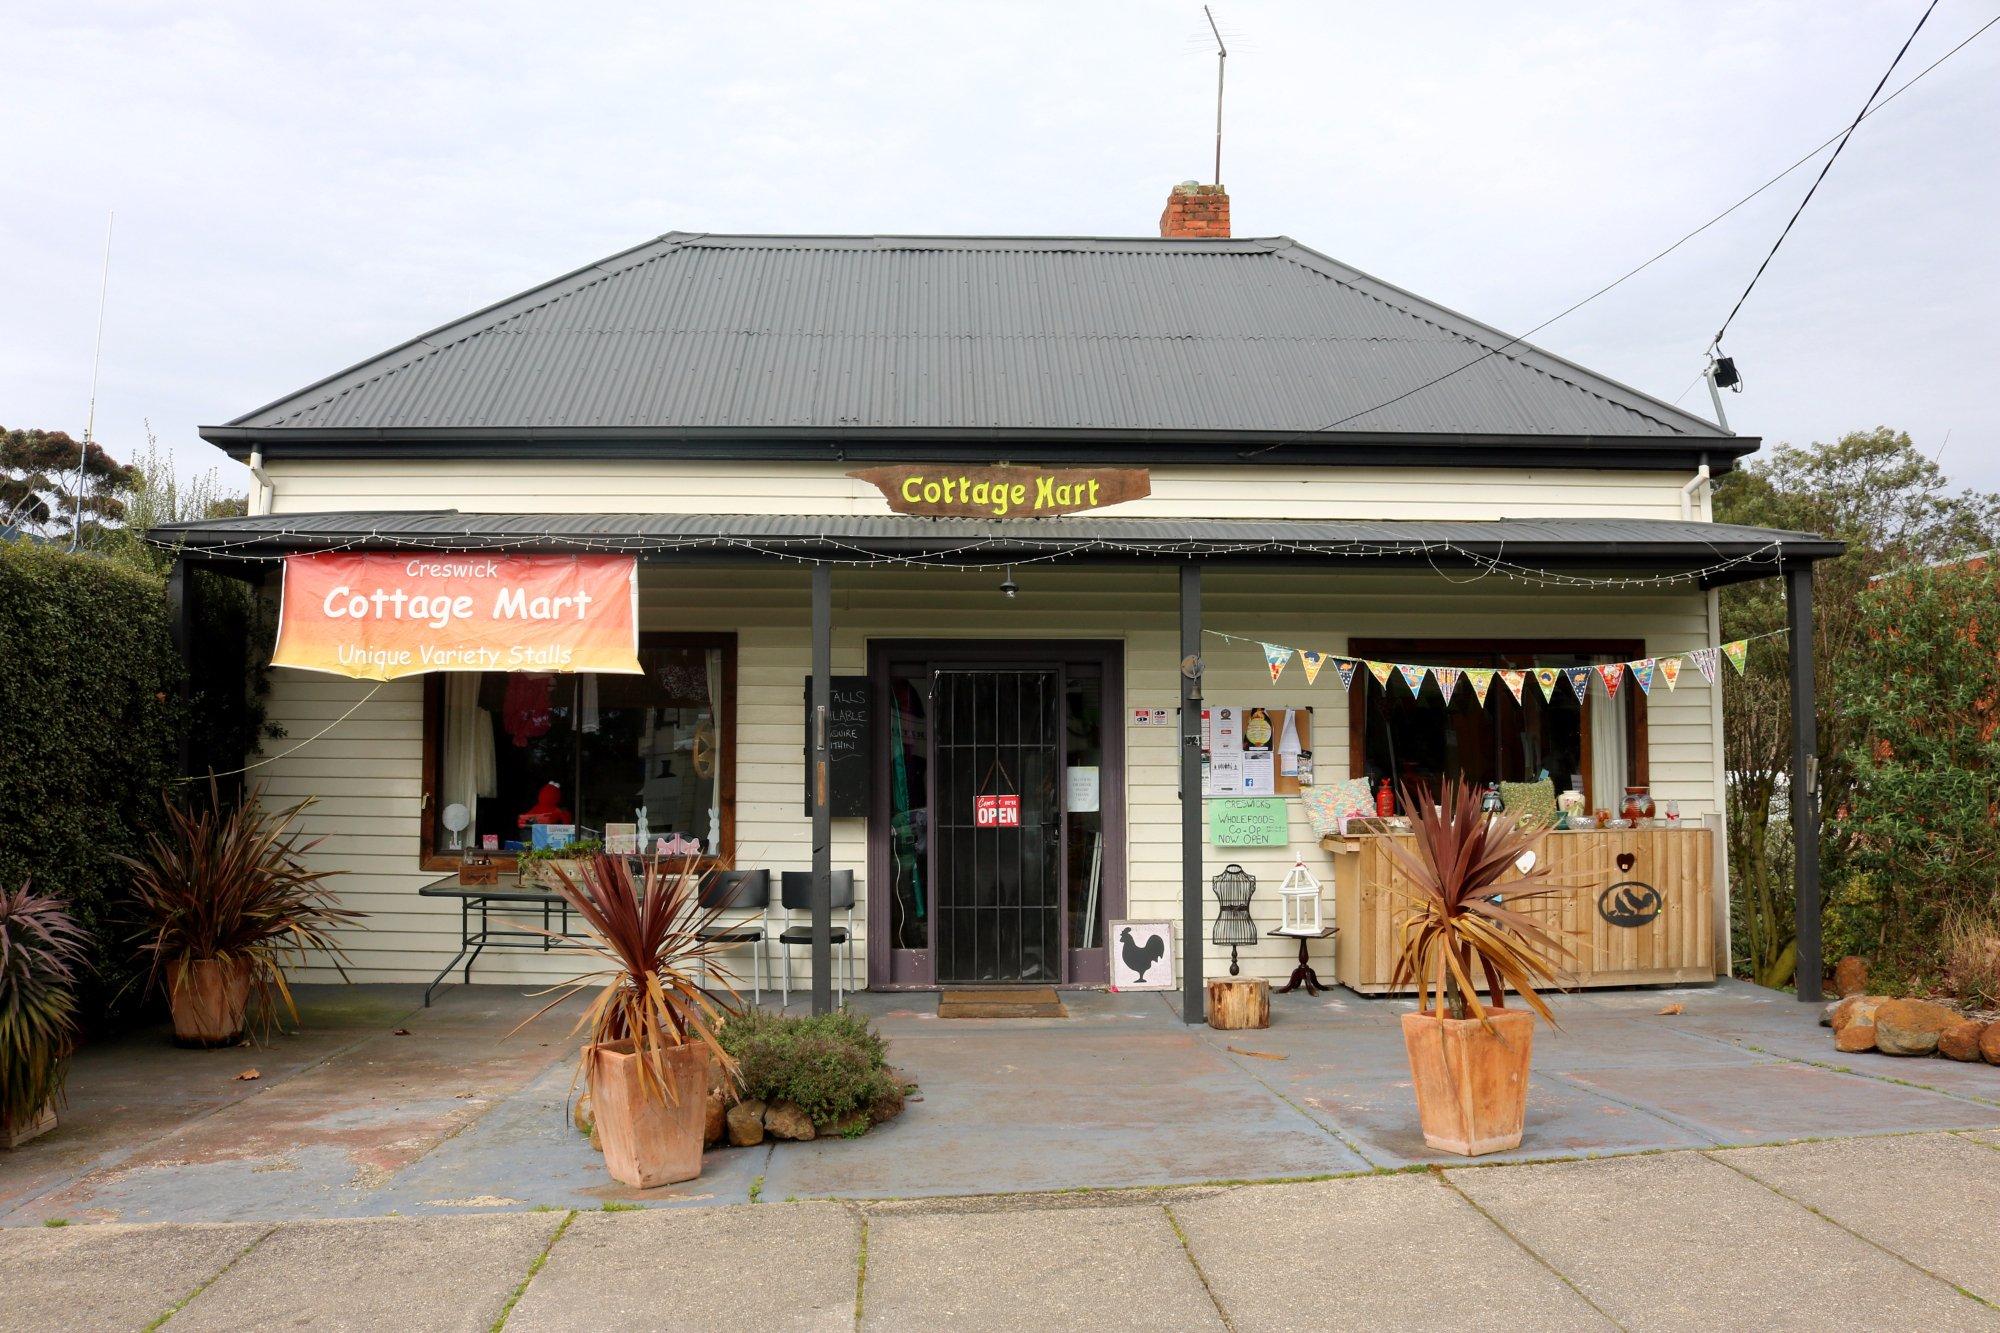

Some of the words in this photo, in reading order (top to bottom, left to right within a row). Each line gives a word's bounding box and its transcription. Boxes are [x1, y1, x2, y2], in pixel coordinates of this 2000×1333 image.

[902, 476, 1025, 515] Cottage
[1034, 476, 1099, 510] Mart
[406, 559, 498, 579] Creswick
[323, 586, 473, 629] Cottage
[492, 587, 592, 621] Mart
[338, 645, 411, 670] Unique
[420, 645, 499, 668] Variety
[509, 645, 573, 666] Stalls
[830, 690, 866, 704] ALLS
[830, 741, 856, 750] ITHIN
[978, 807, 1017, 824] OPEN
[1218, 834, 1240, 844] NOW
[1243, 834, 1269, 844] OPEN
